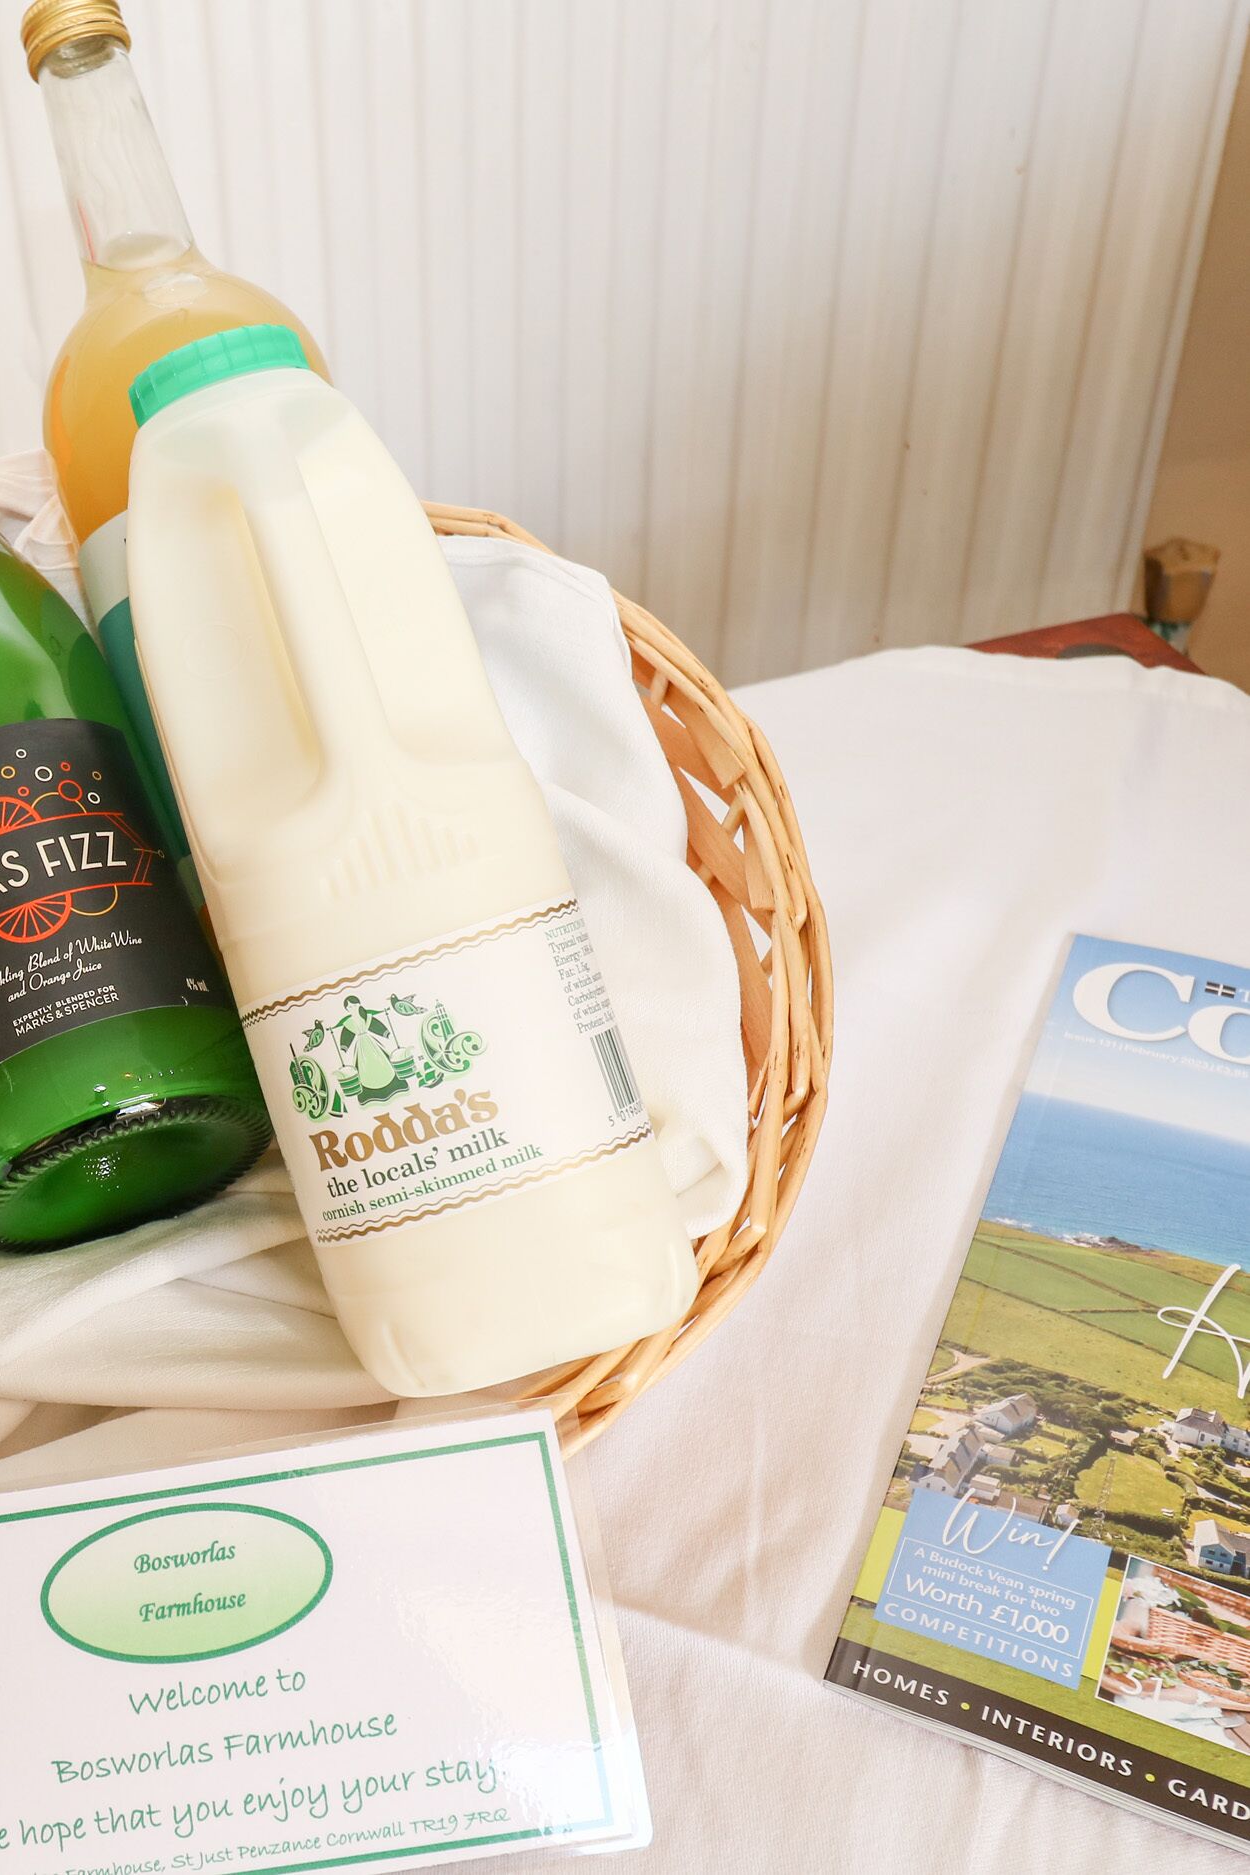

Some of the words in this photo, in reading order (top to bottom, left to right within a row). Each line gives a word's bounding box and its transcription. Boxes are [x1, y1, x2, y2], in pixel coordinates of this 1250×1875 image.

[36, 831, 127, 878] FIZZ
[27, 951, 61, 973] Blend
[63, 942, 74, 963] of
[75, 935, 112, 955] White
[110, 929, 143, 948] Wine
[548, 934, 577, 953] Typical
[7, 983, 27, 1003] and
[29, 972, 72, 991] Orange
[72, 957, 103, 981] Juice
[563, 981, 573, 994] of
[572, 975, 593, 990] which
[12, 1003, 53, 1027] EXPERTLY
[55, 988, 96, 1007] BLENDED
[97, 984, 116, 995] FOR
[15, 1012, 54, 1037] MARKS
[55, 1009, 65, 1019] &
[65, 992, 120, 1016] SPENCER
[573, 1007, 582, 1021] of
[582, 1001, 602, 1017] which
[1125, 1042, 1180, 1064] February
[308, 1088, 499, 1172] Rodda's
[322, 1199, 367, 1222] cornish
[370, 1156, 499, 1211] semi-skimmed
[502, 1143, 544, 1169] milk
[326, 1176, 360, 1199] the
[447, 1127, 510, 1163] milk
[942, 1488, 1081, 1571] Win!
[134, 1540, 236, 1574] Bosworlas
[914, 1547, 926, 1559] A
[929, 1548, 984, 1577] Budock
[986, 1569, 1024, 1590] Vean
[1029, 1584, 1076, 1610] spring
[139, 1592, 247, 1623] Farmhouse
[906, 1573, 984, 1616] Worth
[989, 1604, 1070, 1644] £1,000
[922, 1564, 955, 1582] mini
[959, 1574, 1000, 1597] break
[1004, 1589, 1026, 1605] for
[1030, 1599, 1060, 1617] two
[884, 1602, 1073, 1677] COMPETITIONS
[129, 1675, 268, 1715] Welcome
[275, 1668, 306, 1693] to
[51, 1741, 214, 1784] Bosworlas
[223, 1712, 397, 1761] Farmhouse
[852, 1659, 950, 1707] HOMES
[981, 1704, 1133, 1778] INTERIORS
[1167, 1778, 1250, 1820] GARD
[19, 1816, 87, 1852] hope
[93, 1803, 162, 1835] that
[172, 1798, 234, 1838] you
[243, 1777, 328, 1822] enjoy
[341, 1769, 416, 1814] your
[171, 1852, 197, 1869] St
[191, 1847, 234, 1870] Just
[237, 1835, 321, 1859] Penzance
[326, 1821, 405, 1846] Cornwall
[410, 1814, 459, 1836] TR19
[464, 1808, 512, 1830] 7RQ
